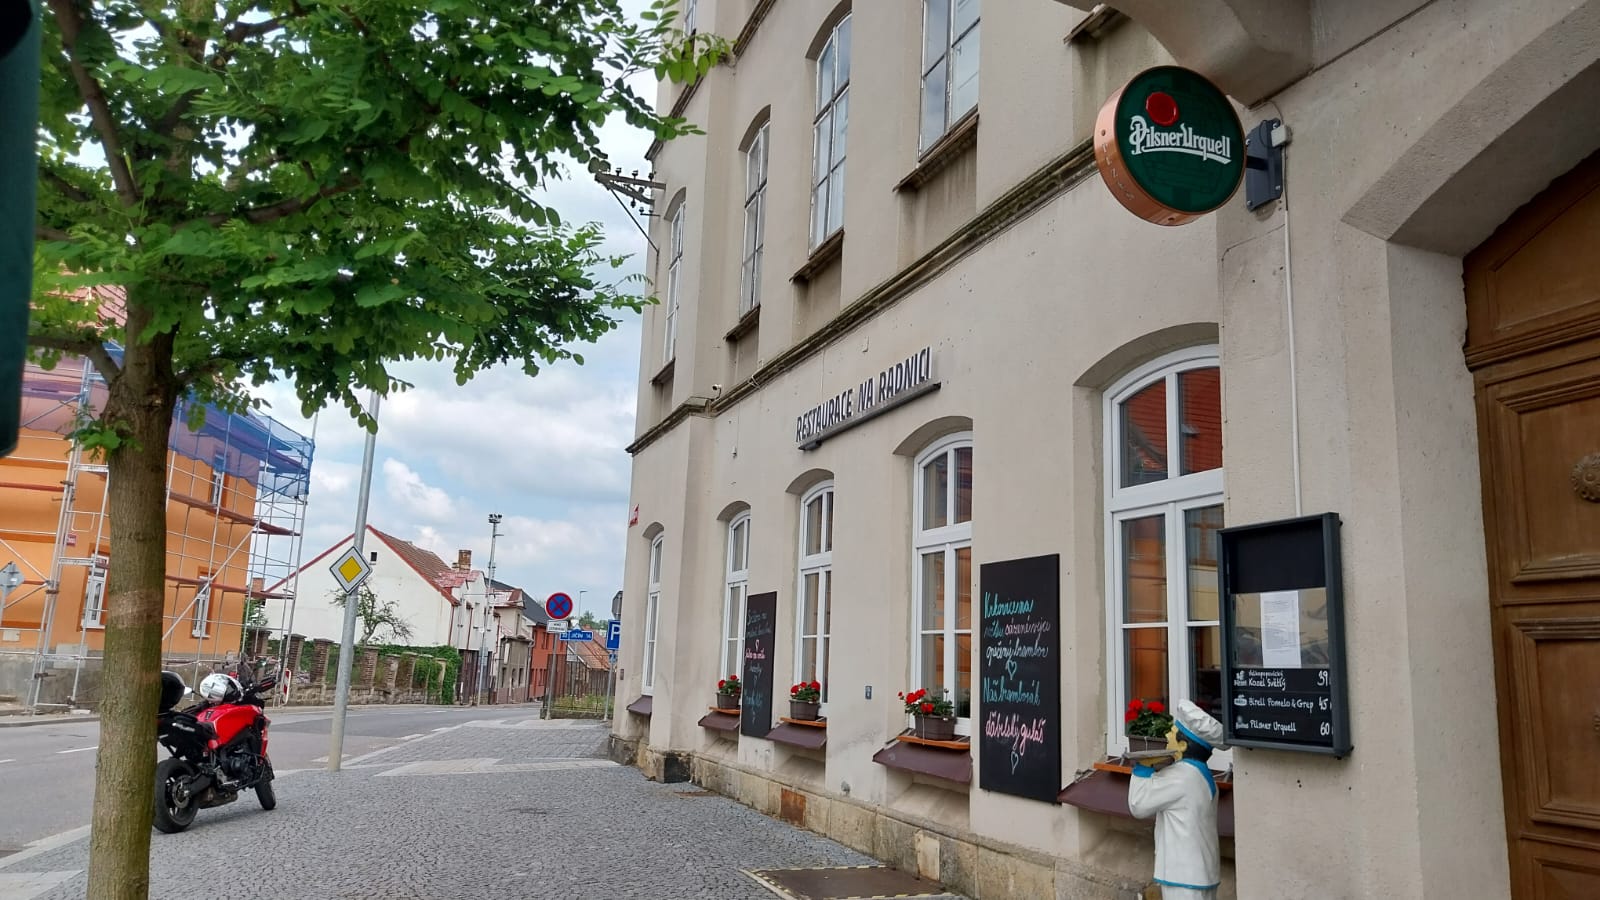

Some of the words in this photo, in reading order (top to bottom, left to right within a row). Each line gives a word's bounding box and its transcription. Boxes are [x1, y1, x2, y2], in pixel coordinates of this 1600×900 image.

[1129, 115, 1184, 155] Pilsner
[1181, 123, 1231, 161] Urquell
[796, 388, 854, 443] RESTAURACE
[858, 377, 876, 412] NA
[879, 346, 932, 402] RADNICI
[610, 624, 620, 641] P
[1249, 678, 1266, 687] Kozel
[1267, 678, 1286, 691] Světlý
[1317, 670, 1328, 687] 39
[1248, 697, 1266, 707] Birell
[1267, 697, 1290, 708] Pomelo
[1296, 699, 1314, 713] Grep
[1318, 696, 1329, 710] 45
[1250, 719, 1272, 730] Pilsner
[1273, 721, 1297, 735] Urquell
[1320, 721, 1330, 736] 60
